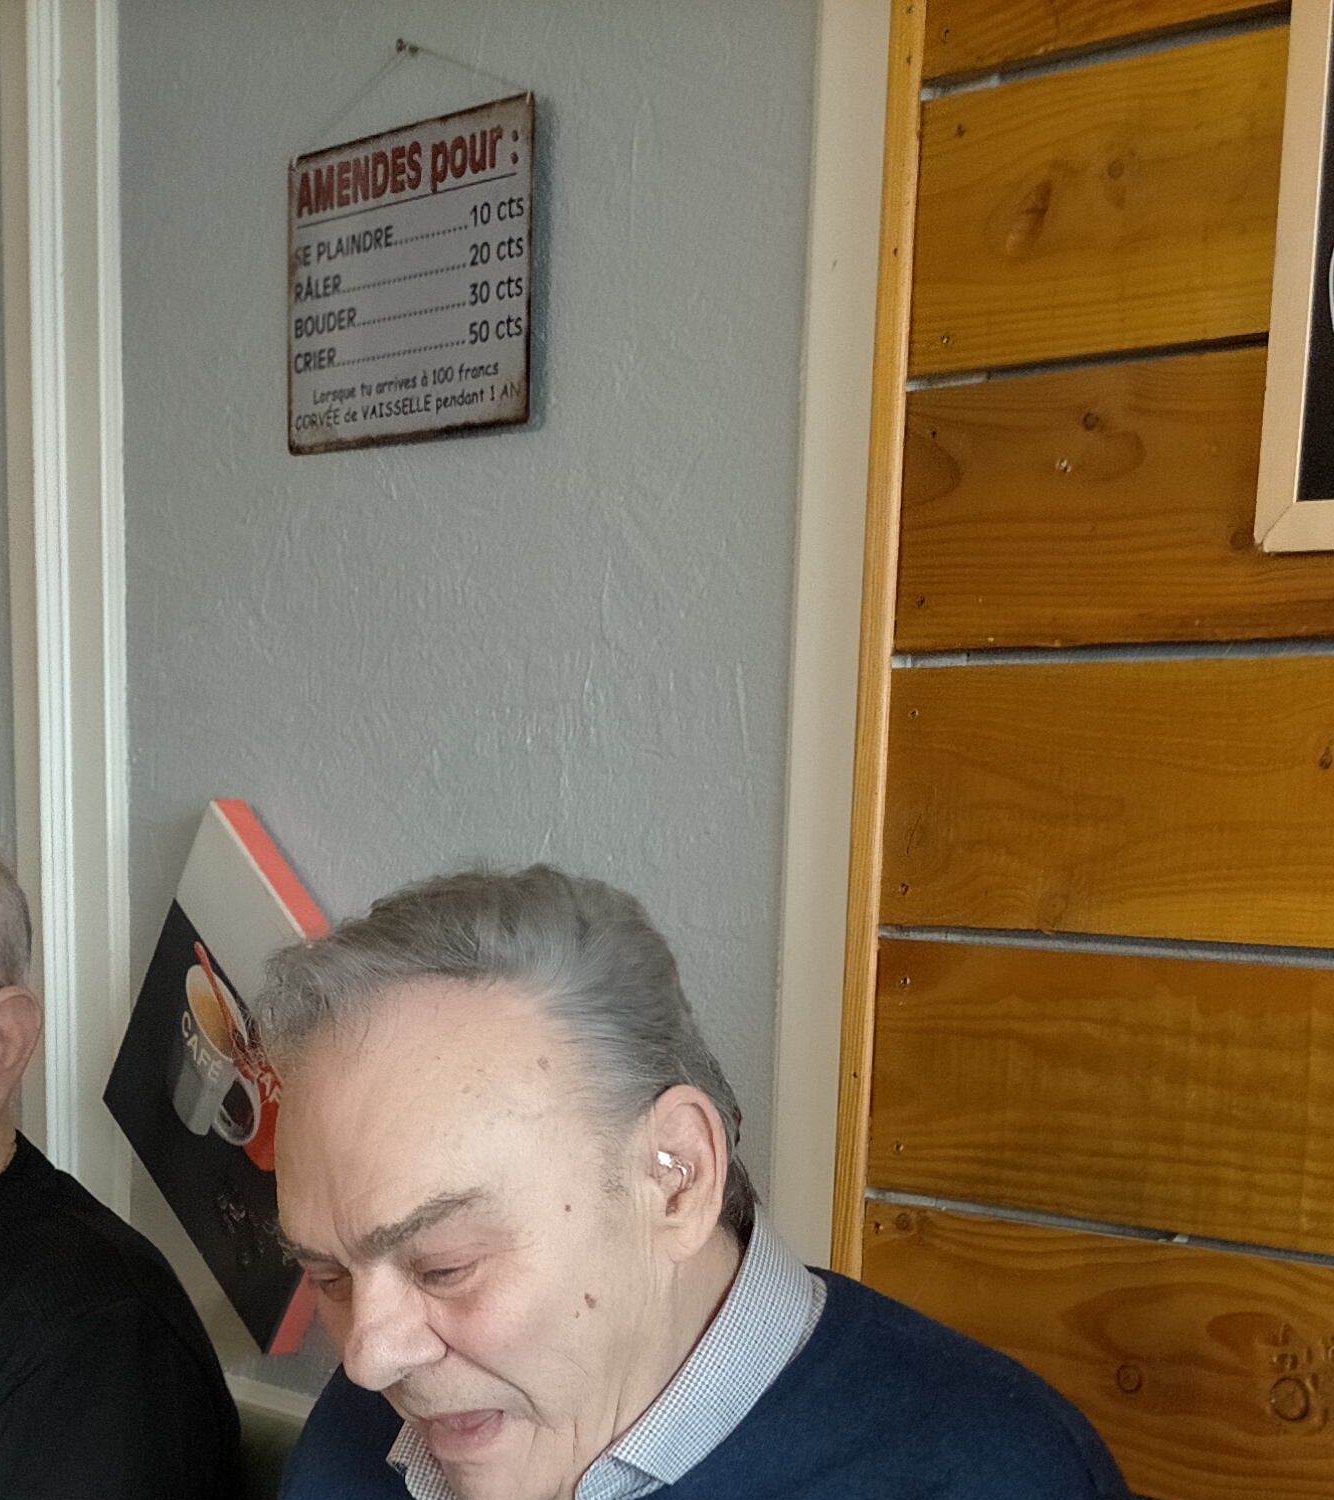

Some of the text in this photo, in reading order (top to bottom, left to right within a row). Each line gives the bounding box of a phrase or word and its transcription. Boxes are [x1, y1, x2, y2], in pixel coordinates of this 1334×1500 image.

[297, 141, 423, 218] AMENDES
[431, 124, 503, 195] pour
[317, 225, 394, 263] PLAINDRE
[470, 202, 491, 228] 10
[497, 196, 524, 223] cts
[294, 236, 524, 304] RÂLER 20 cts
[294, 275, 523, 340] BOUDER 30 cts
[294, 315, 523, 375] CRIER 50 cts
[295, 404, 340, 431] CORVÉE
[344, 407, 358, 423] de
[362, 394, 432, 420] VAISSELLE
[436, 388, 485, 414] pendant
[500, 381, 520, 400] AN
[313, 361, 499, 406] Lorsque tu arrives à 100 francs
[181, 1009, 223, 1083] CAFÉ
